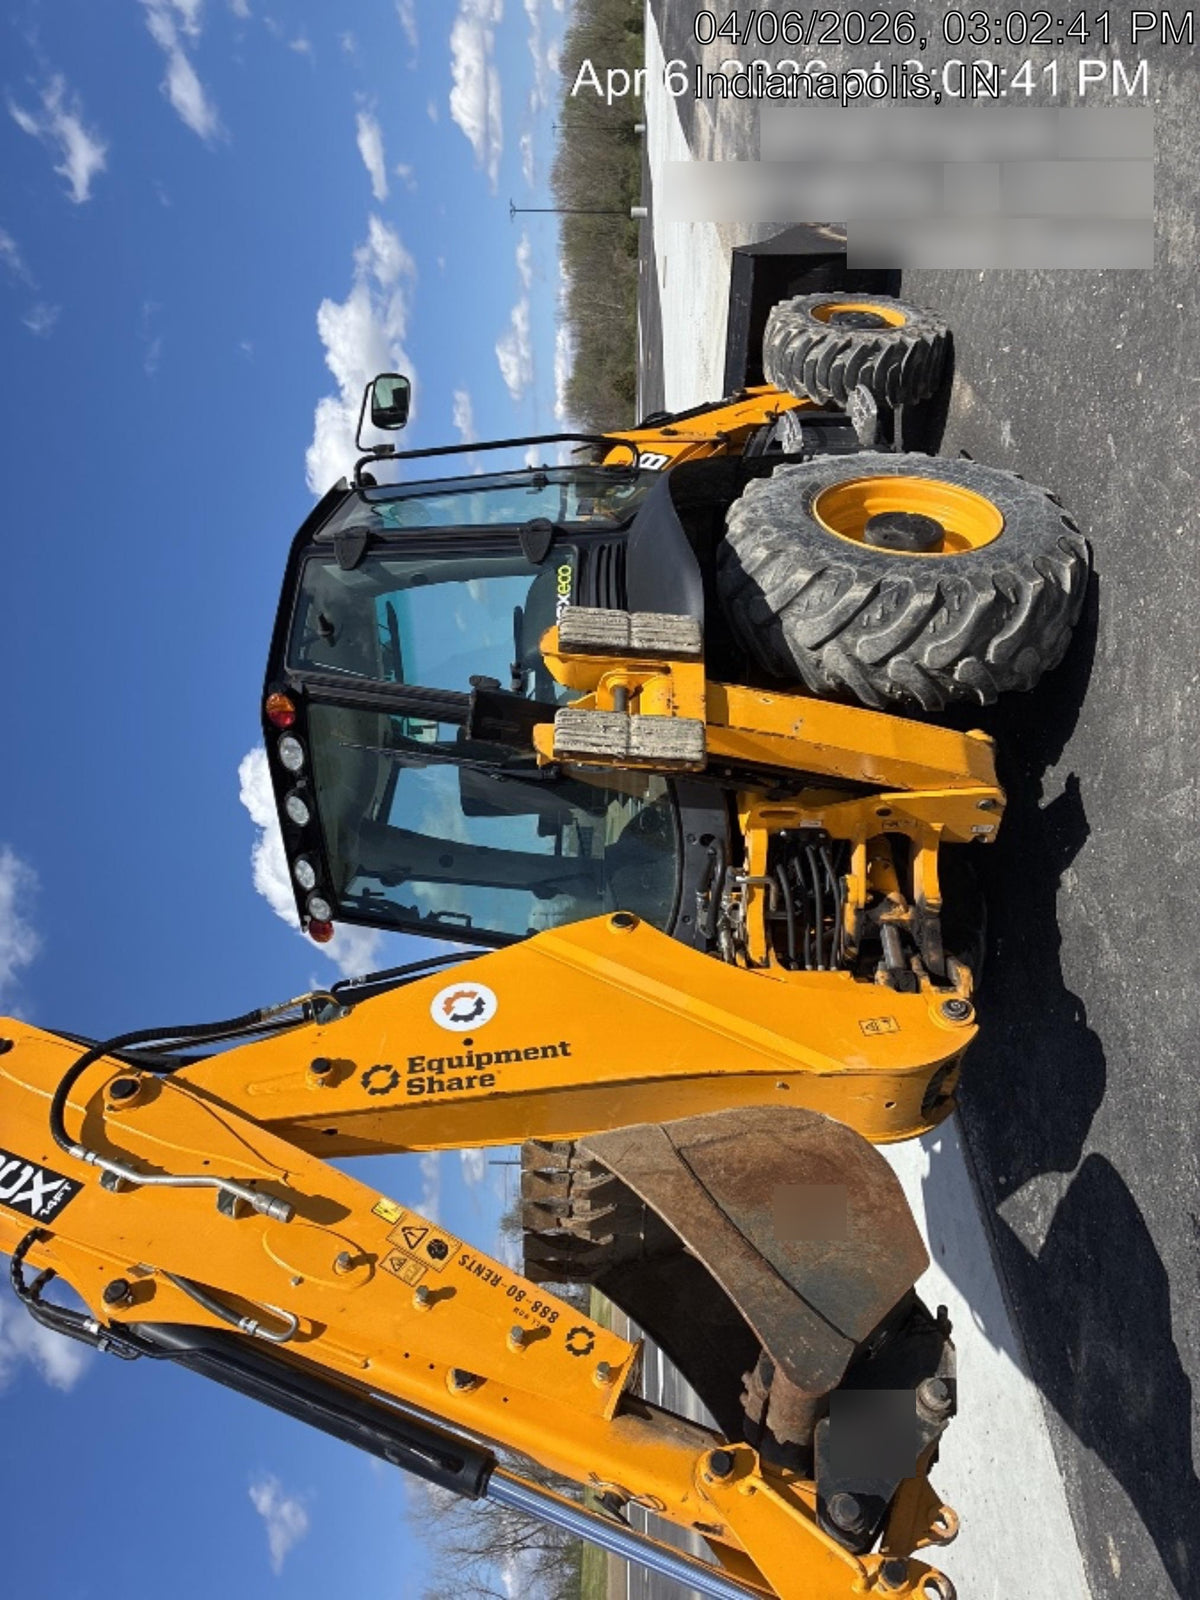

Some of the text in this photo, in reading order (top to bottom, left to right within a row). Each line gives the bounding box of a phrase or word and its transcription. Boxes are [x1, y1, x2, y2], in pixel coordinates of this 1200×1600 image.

[406, 1040, 572, 1075] Equipment
[406, 1072, 496, 1097] Share
[458, 1254, 560, 1325] 888-80-RENTS
